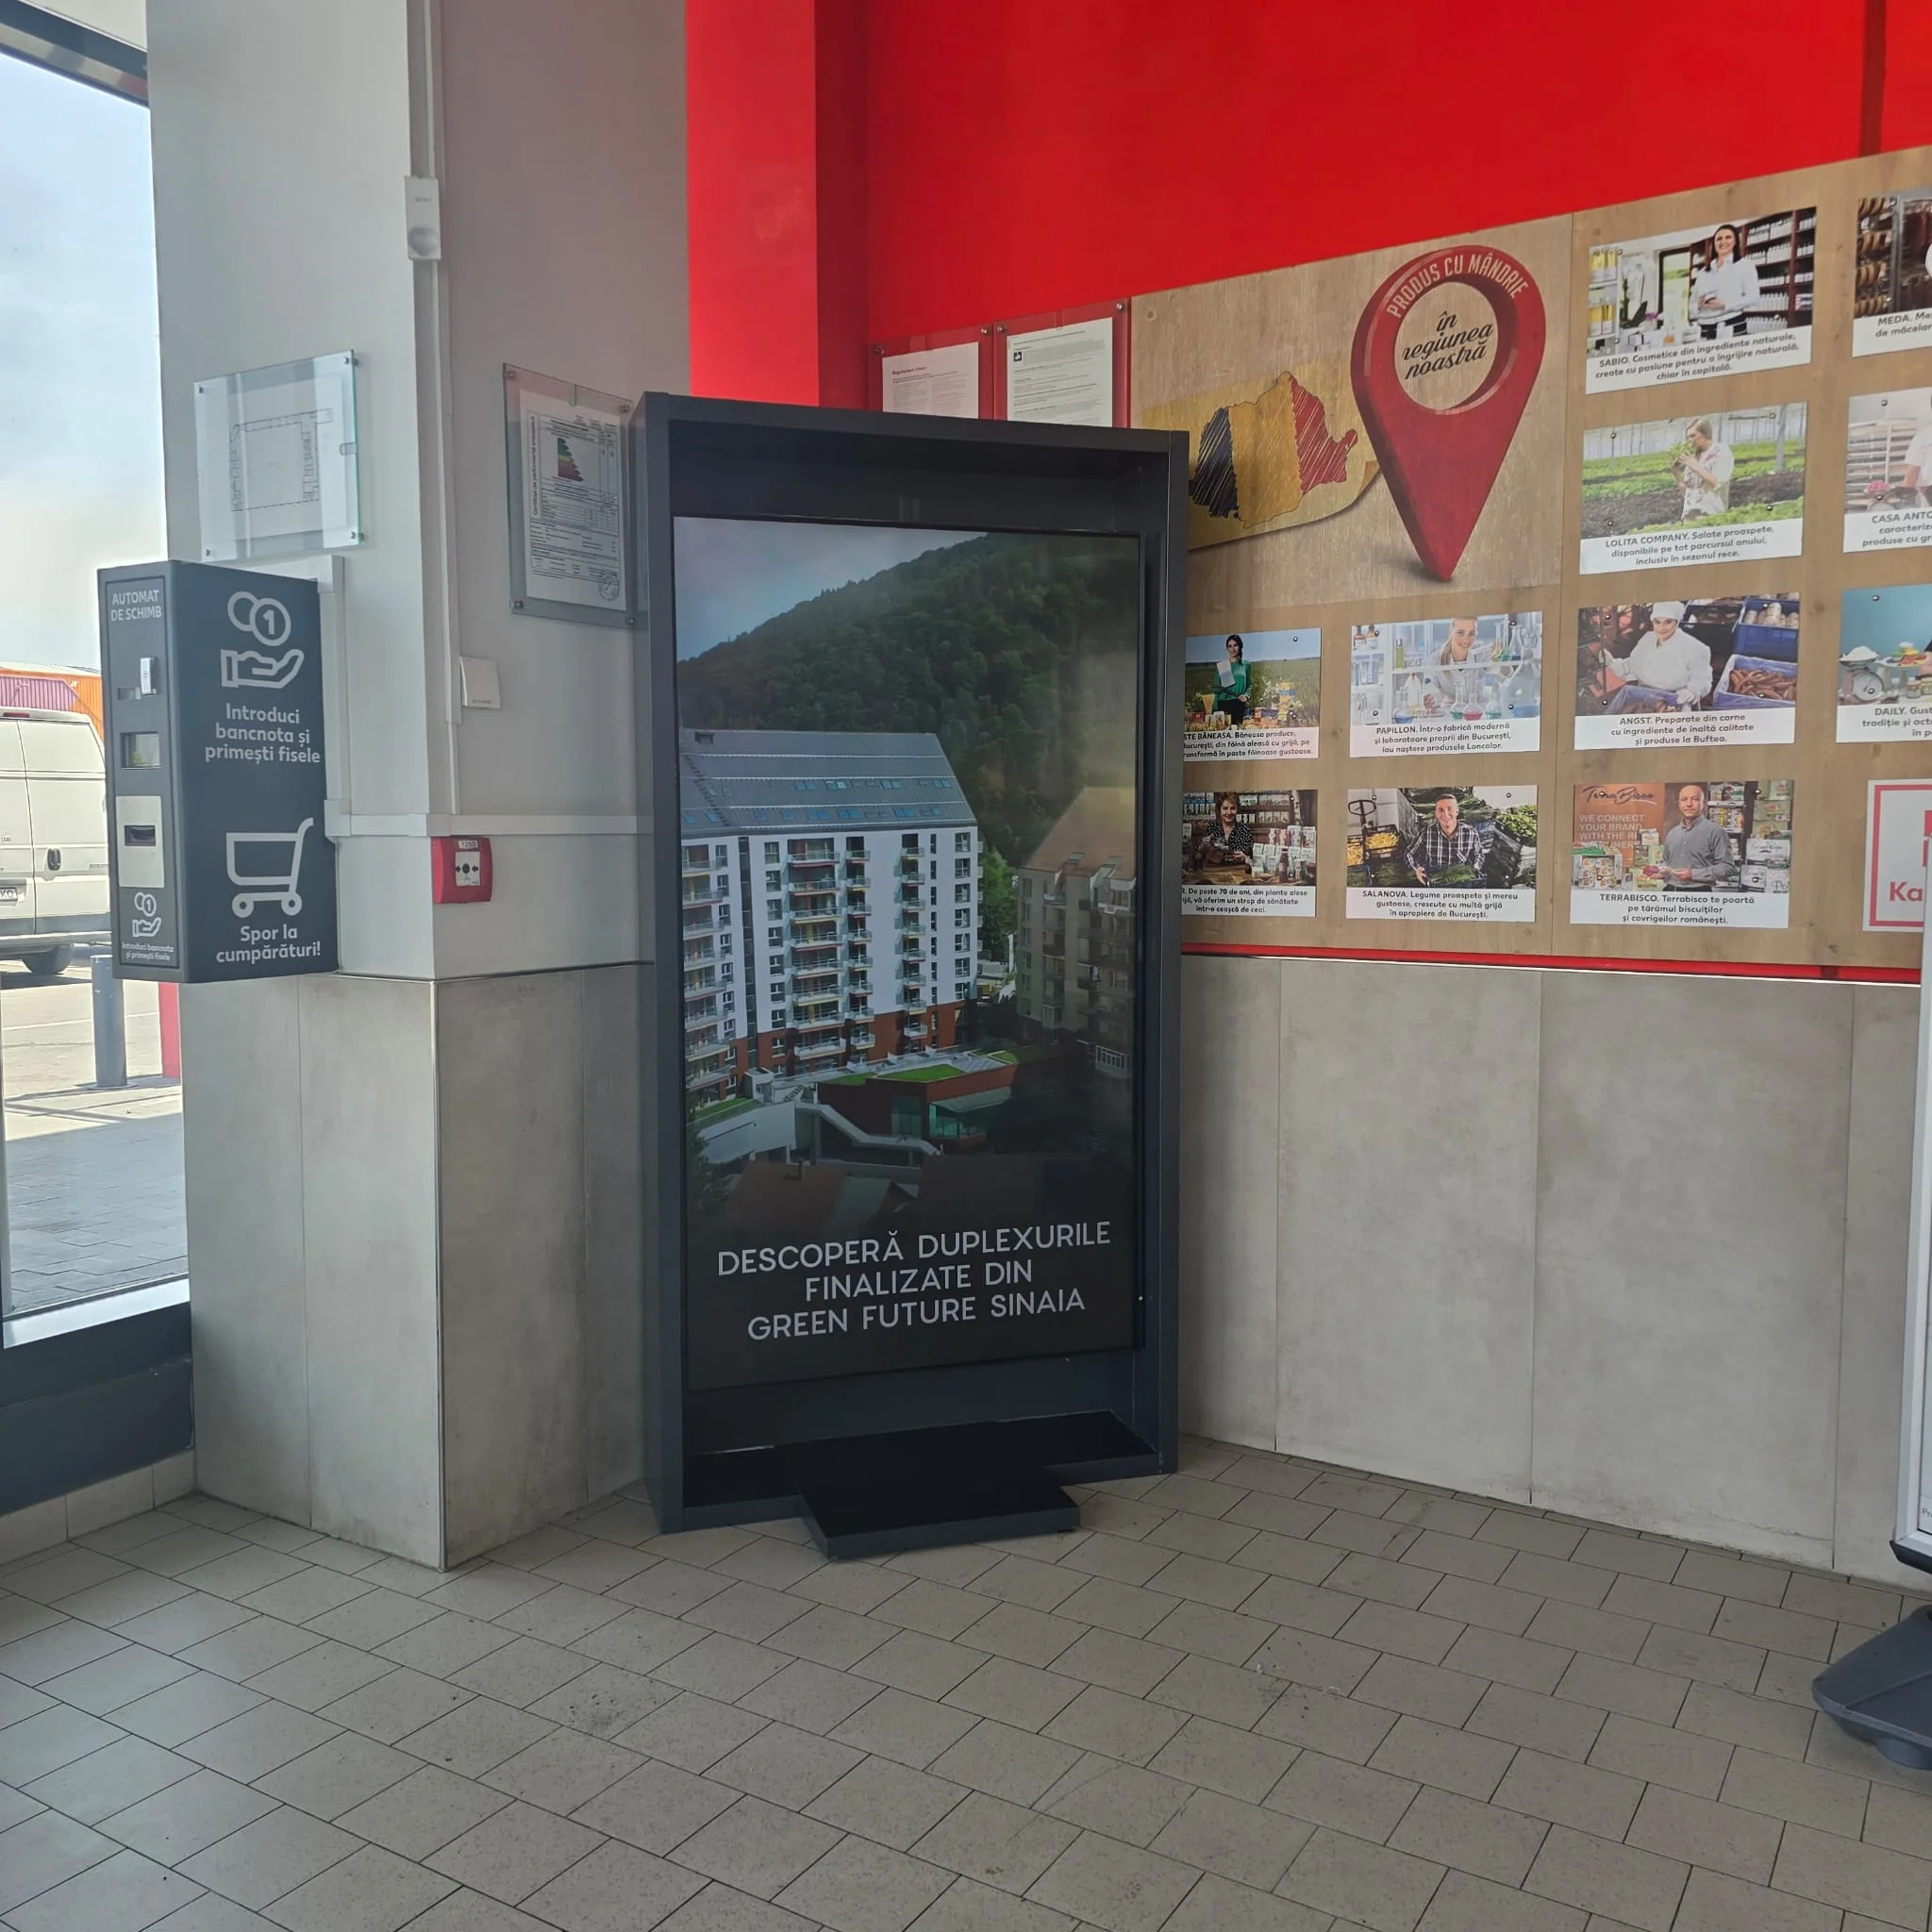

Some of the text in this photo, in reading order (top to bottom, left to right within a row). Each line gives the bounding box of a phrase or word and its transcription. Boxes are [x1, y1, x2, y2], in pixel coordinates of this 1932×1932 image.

[1387, 253, 1528, 318] PRODUS CU MÂNDRIE
[1436, 310, 1457, 333] în
[1403, 324, 1493, 360] regiunea
[1405, 341, 1487, 379] noastră
[1872, 514, 1900, 524] CASA
[112, 590, 158, 605] AUTOMAT
[111, 606, 162, 621] DE SCHIMB
[226, 703, 299, 724] Introduci
[216, 723, 309, 747] bancnota și
[206, 744, 320, 764] primești fisele
[1890, 882, 1923, 902] Ka
[241, 924, 297, 944] Spor la
[216, 941, 321, 964] cumpărături!
[719, 1222, 1110, 1275] DESCOPERĂ DUPLEXURILE
[806, 1259, 1032, 1302] FINALIZATE DIN
[748, 1288, 1085, 1340] GREEN FUTURE SINAIA
